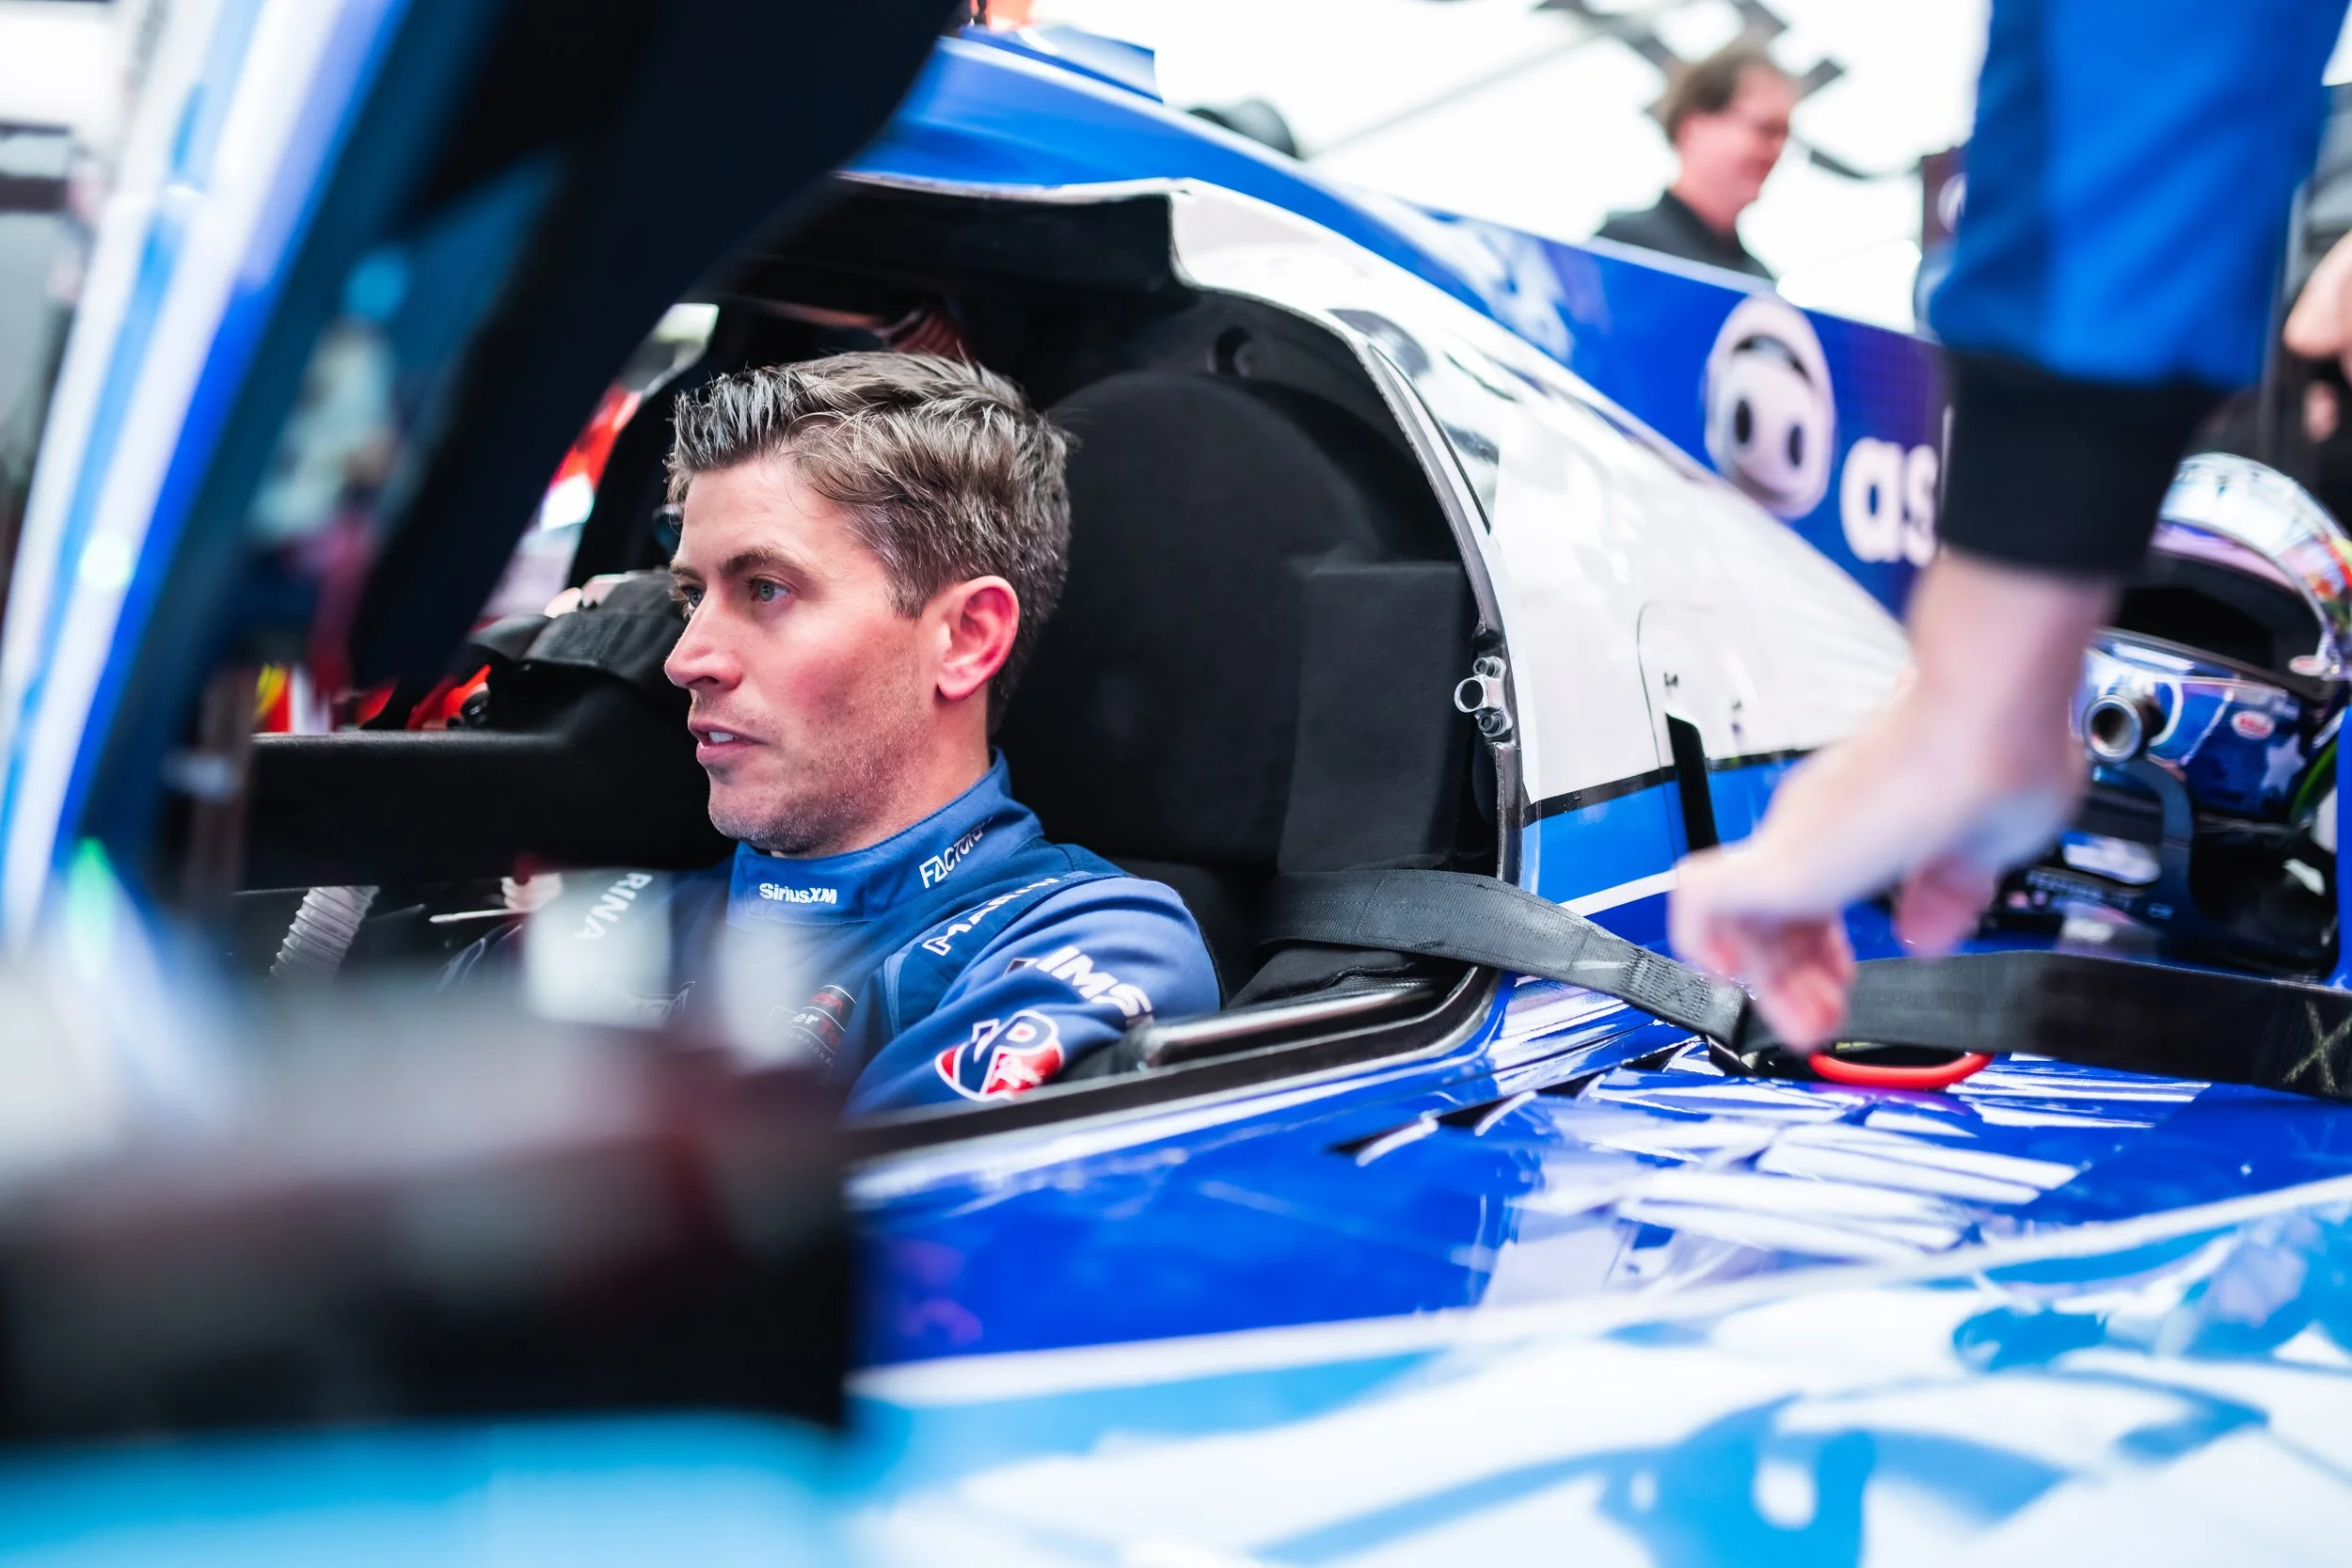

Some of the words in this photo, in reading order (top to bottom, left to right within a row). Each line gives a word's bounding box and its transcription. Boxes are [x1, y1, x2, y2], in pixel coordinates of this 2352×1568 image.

[1838, 436, 1951, 567] as
[758, 882, 837, 904] SiriusXM
[1036, 944, 1154, 1022] IMS
